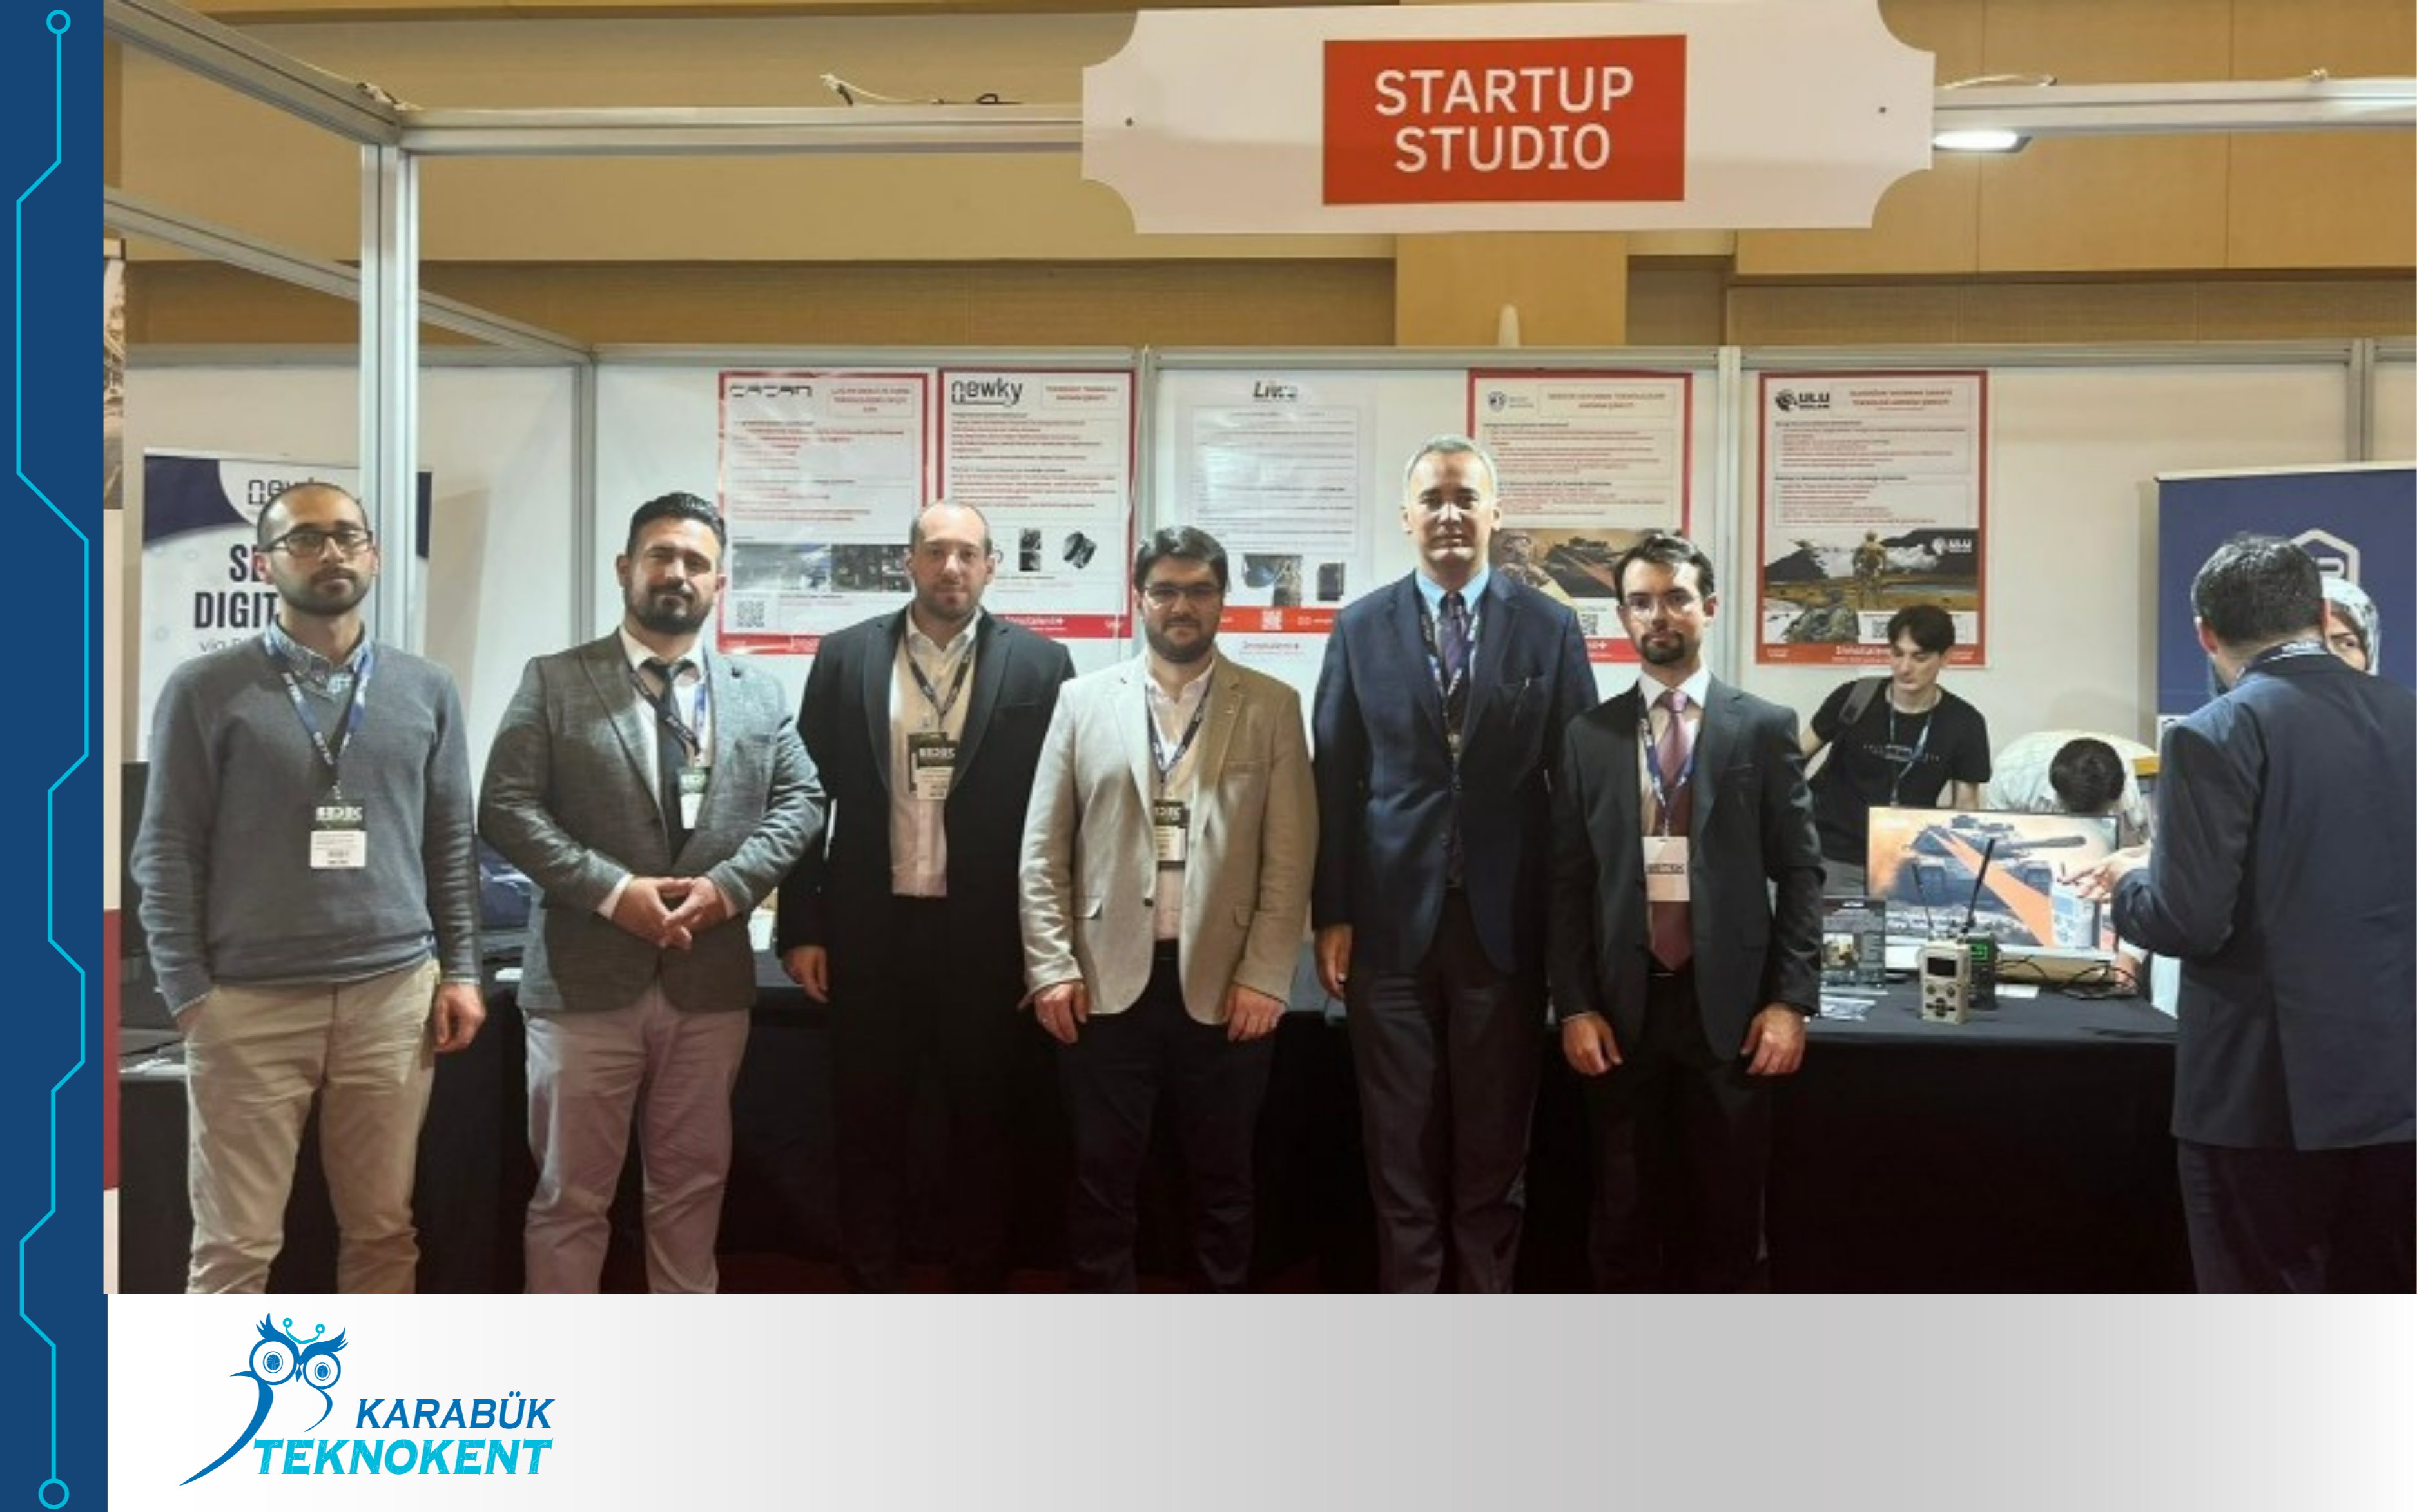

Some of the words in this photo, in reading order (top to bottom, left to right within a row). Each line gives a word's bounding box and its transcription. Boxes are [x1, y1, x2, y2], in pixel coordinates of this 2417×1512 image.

[1375, 66, 1634, 116] STARTUP
[1395, 123, 1611, 172] STUDIO
[951, 377, 1023, 407] newky
[195, 591, 280, 628] DIGIT
